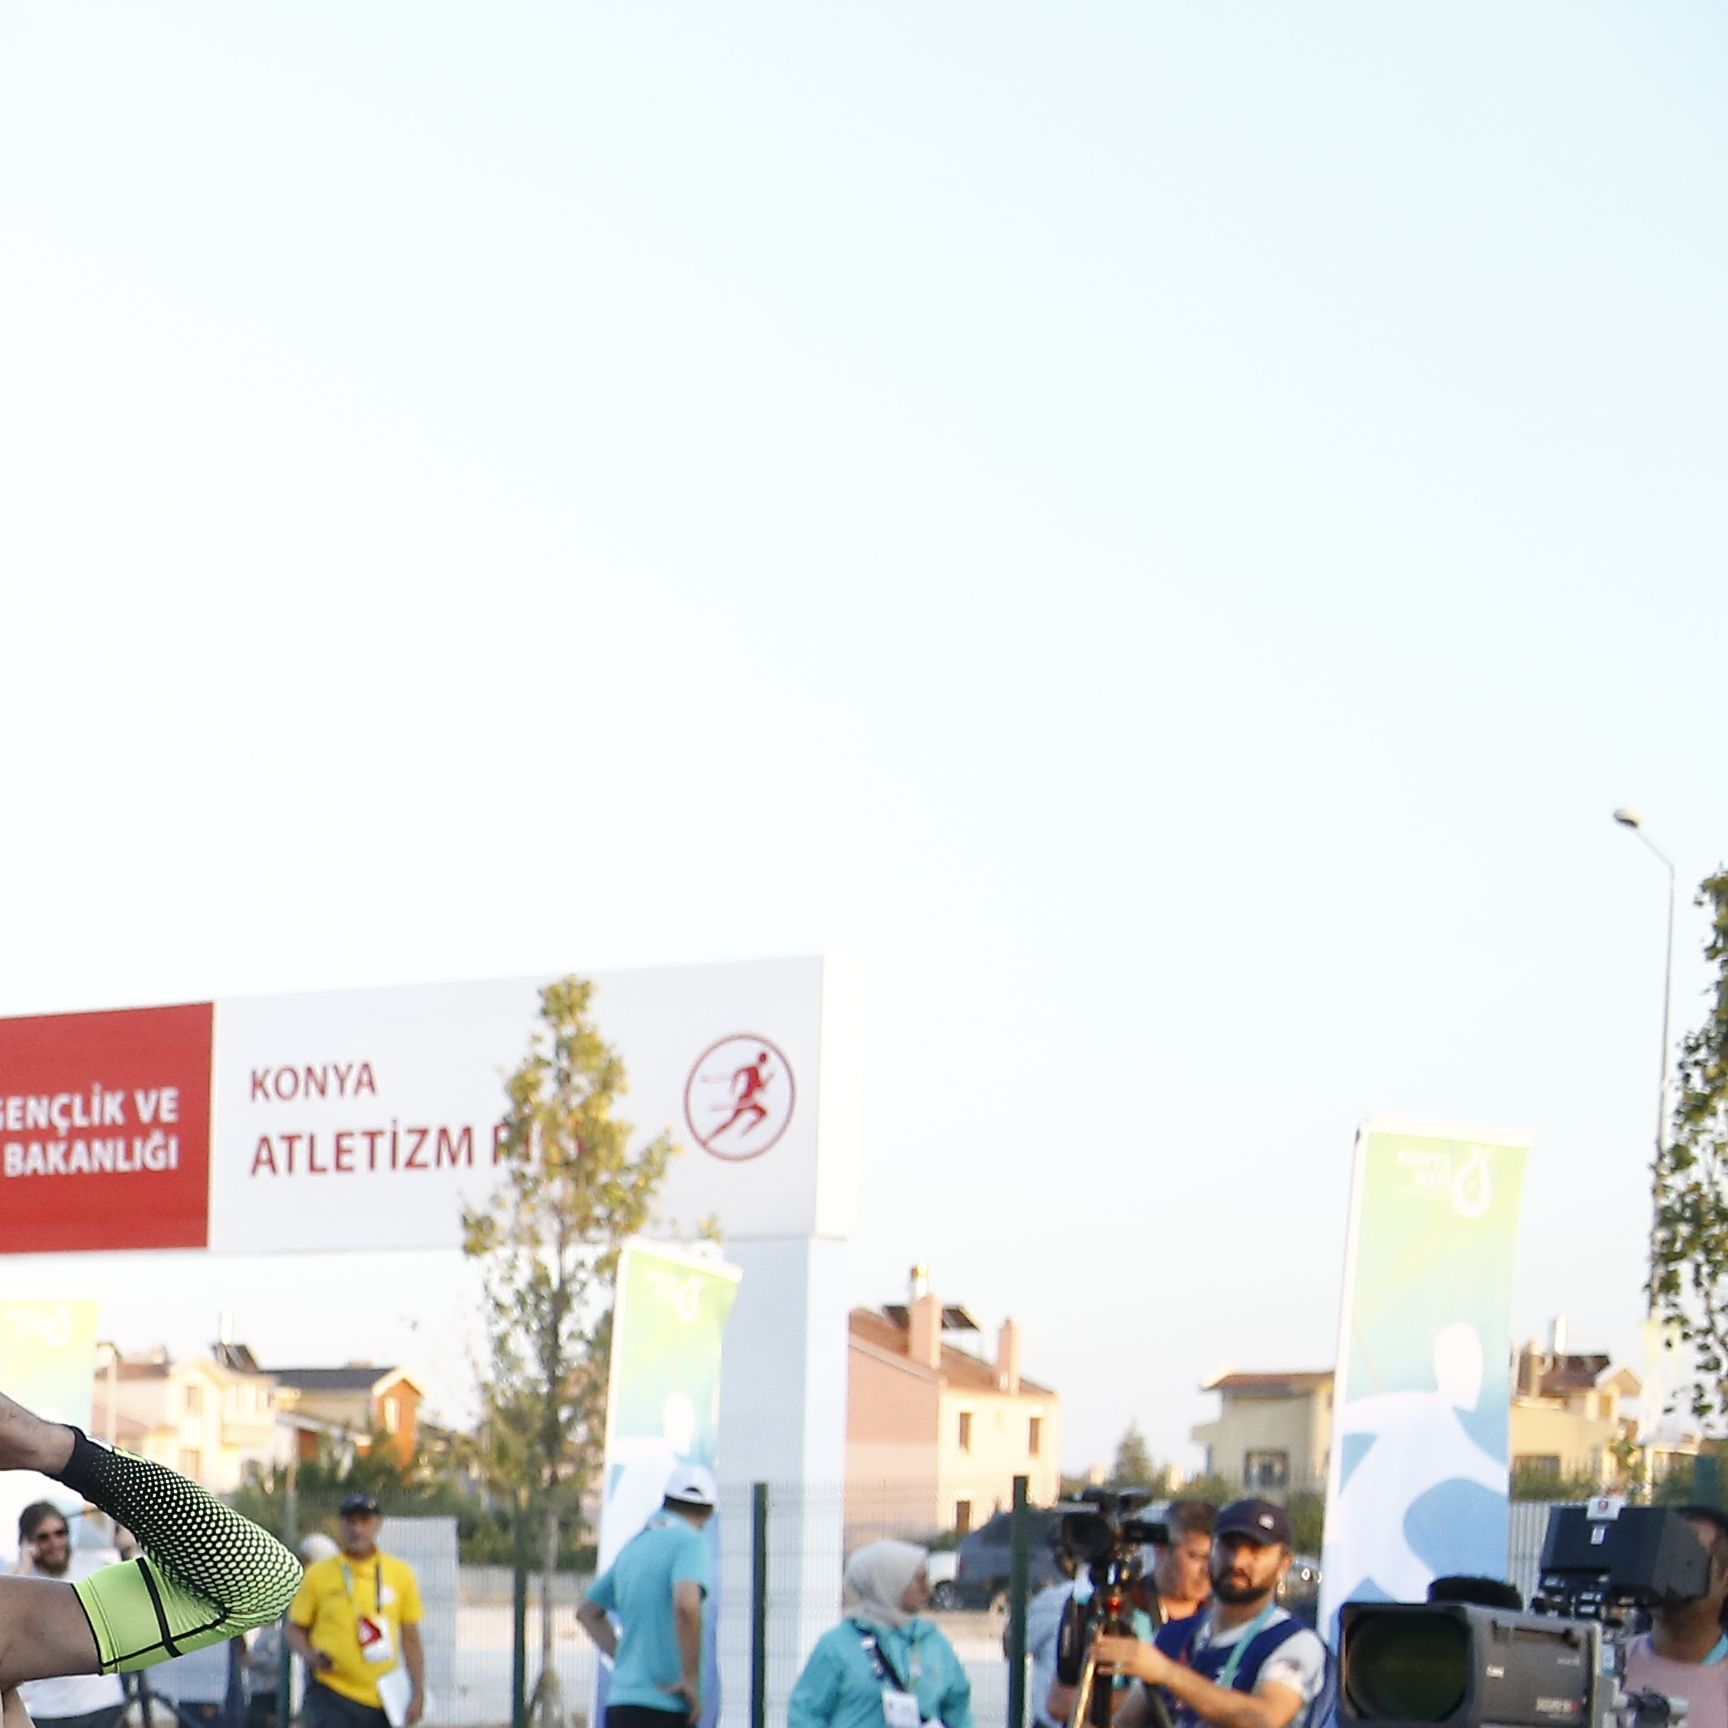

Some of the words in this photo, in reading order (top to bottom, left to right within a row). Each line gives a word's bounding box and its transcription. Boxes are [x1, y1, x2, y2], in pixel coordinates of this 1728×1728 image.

[250, 1061, 377, 1102] KONYA
[134, 1086, 179, 1124] VE
[4, 1129, 179, 1178] BAKANLIĞI
[251, 1115, 475, 1178] ATLETİZM
